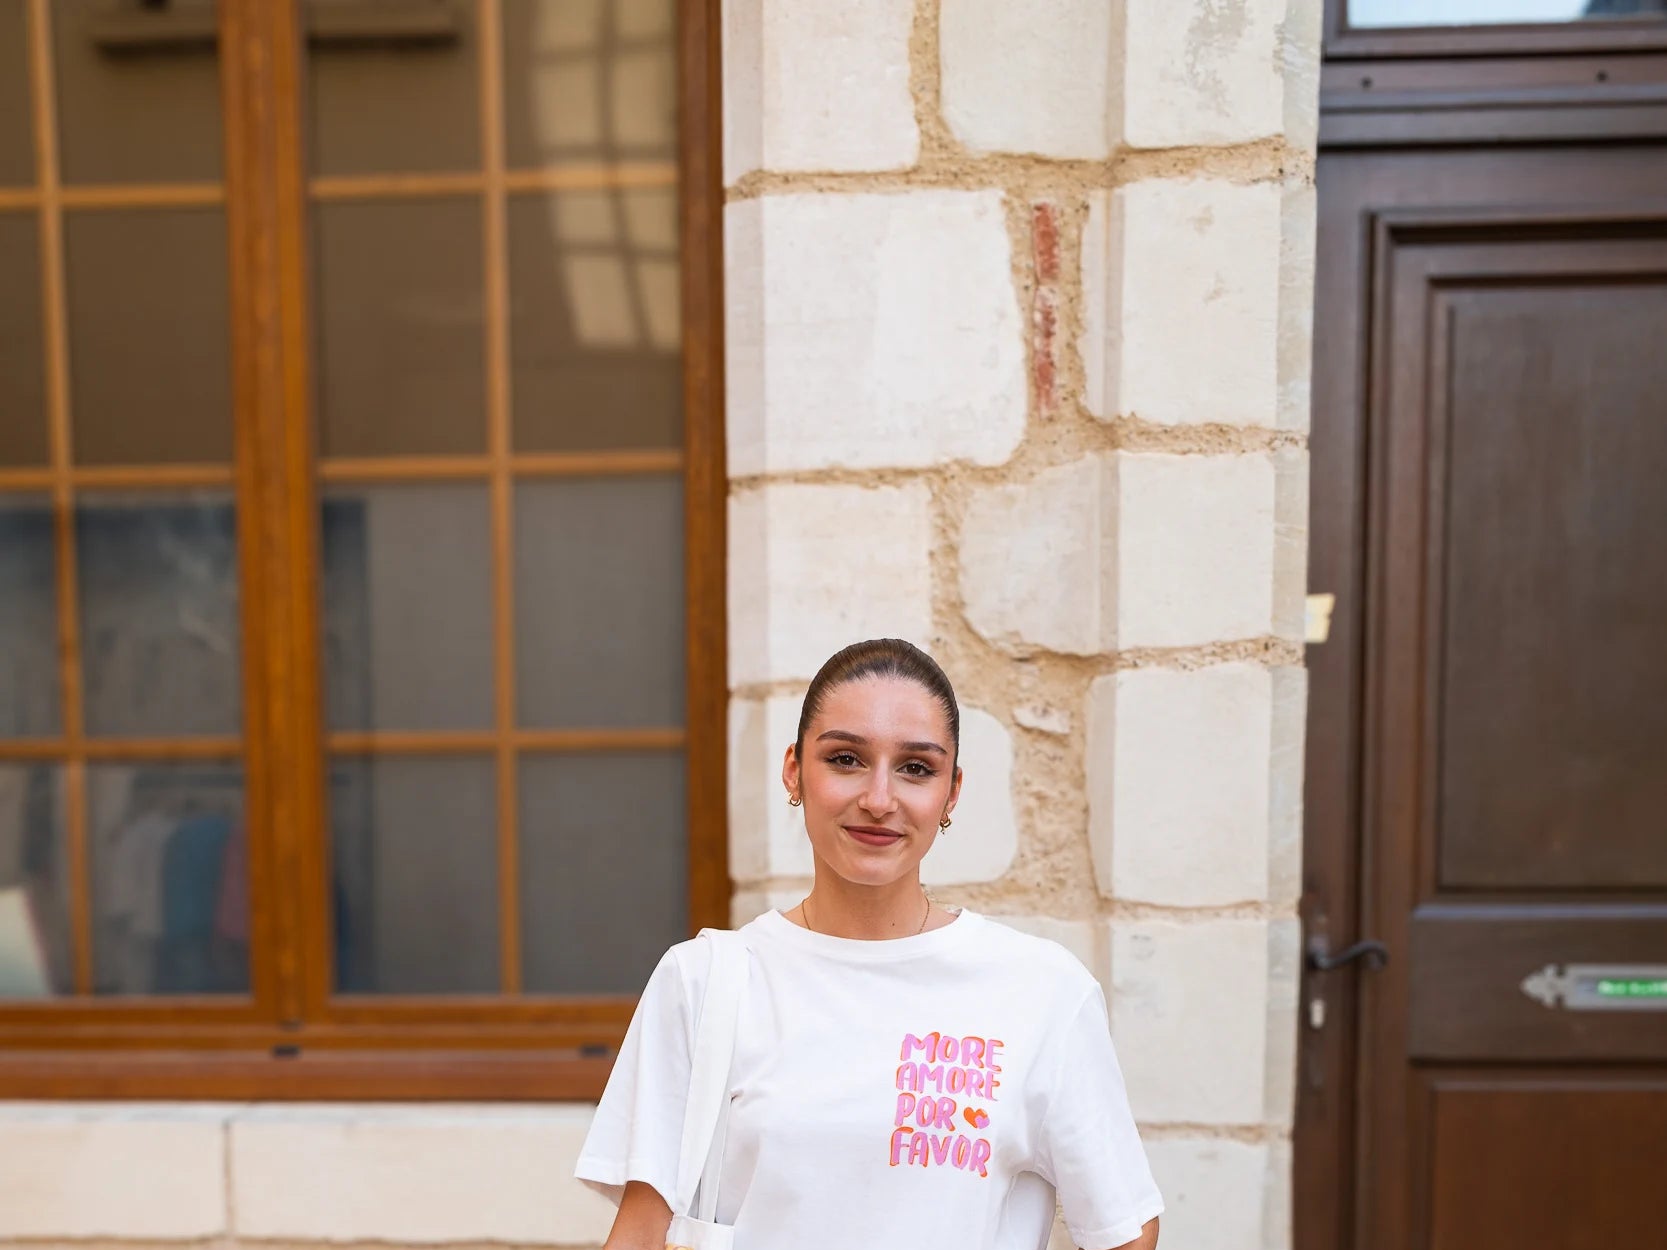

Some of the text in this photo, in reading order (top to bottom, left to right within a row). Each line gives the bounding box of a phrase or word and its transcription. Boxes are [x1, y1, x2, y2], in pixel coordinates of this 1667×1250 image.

[900, 1032, 1004, 1072] MORE
[896, 1062, 1001, 1101] AMORE
[894, 1092, 957, 1131] POR
[890, 1126, 991, 1177] FAVOR
